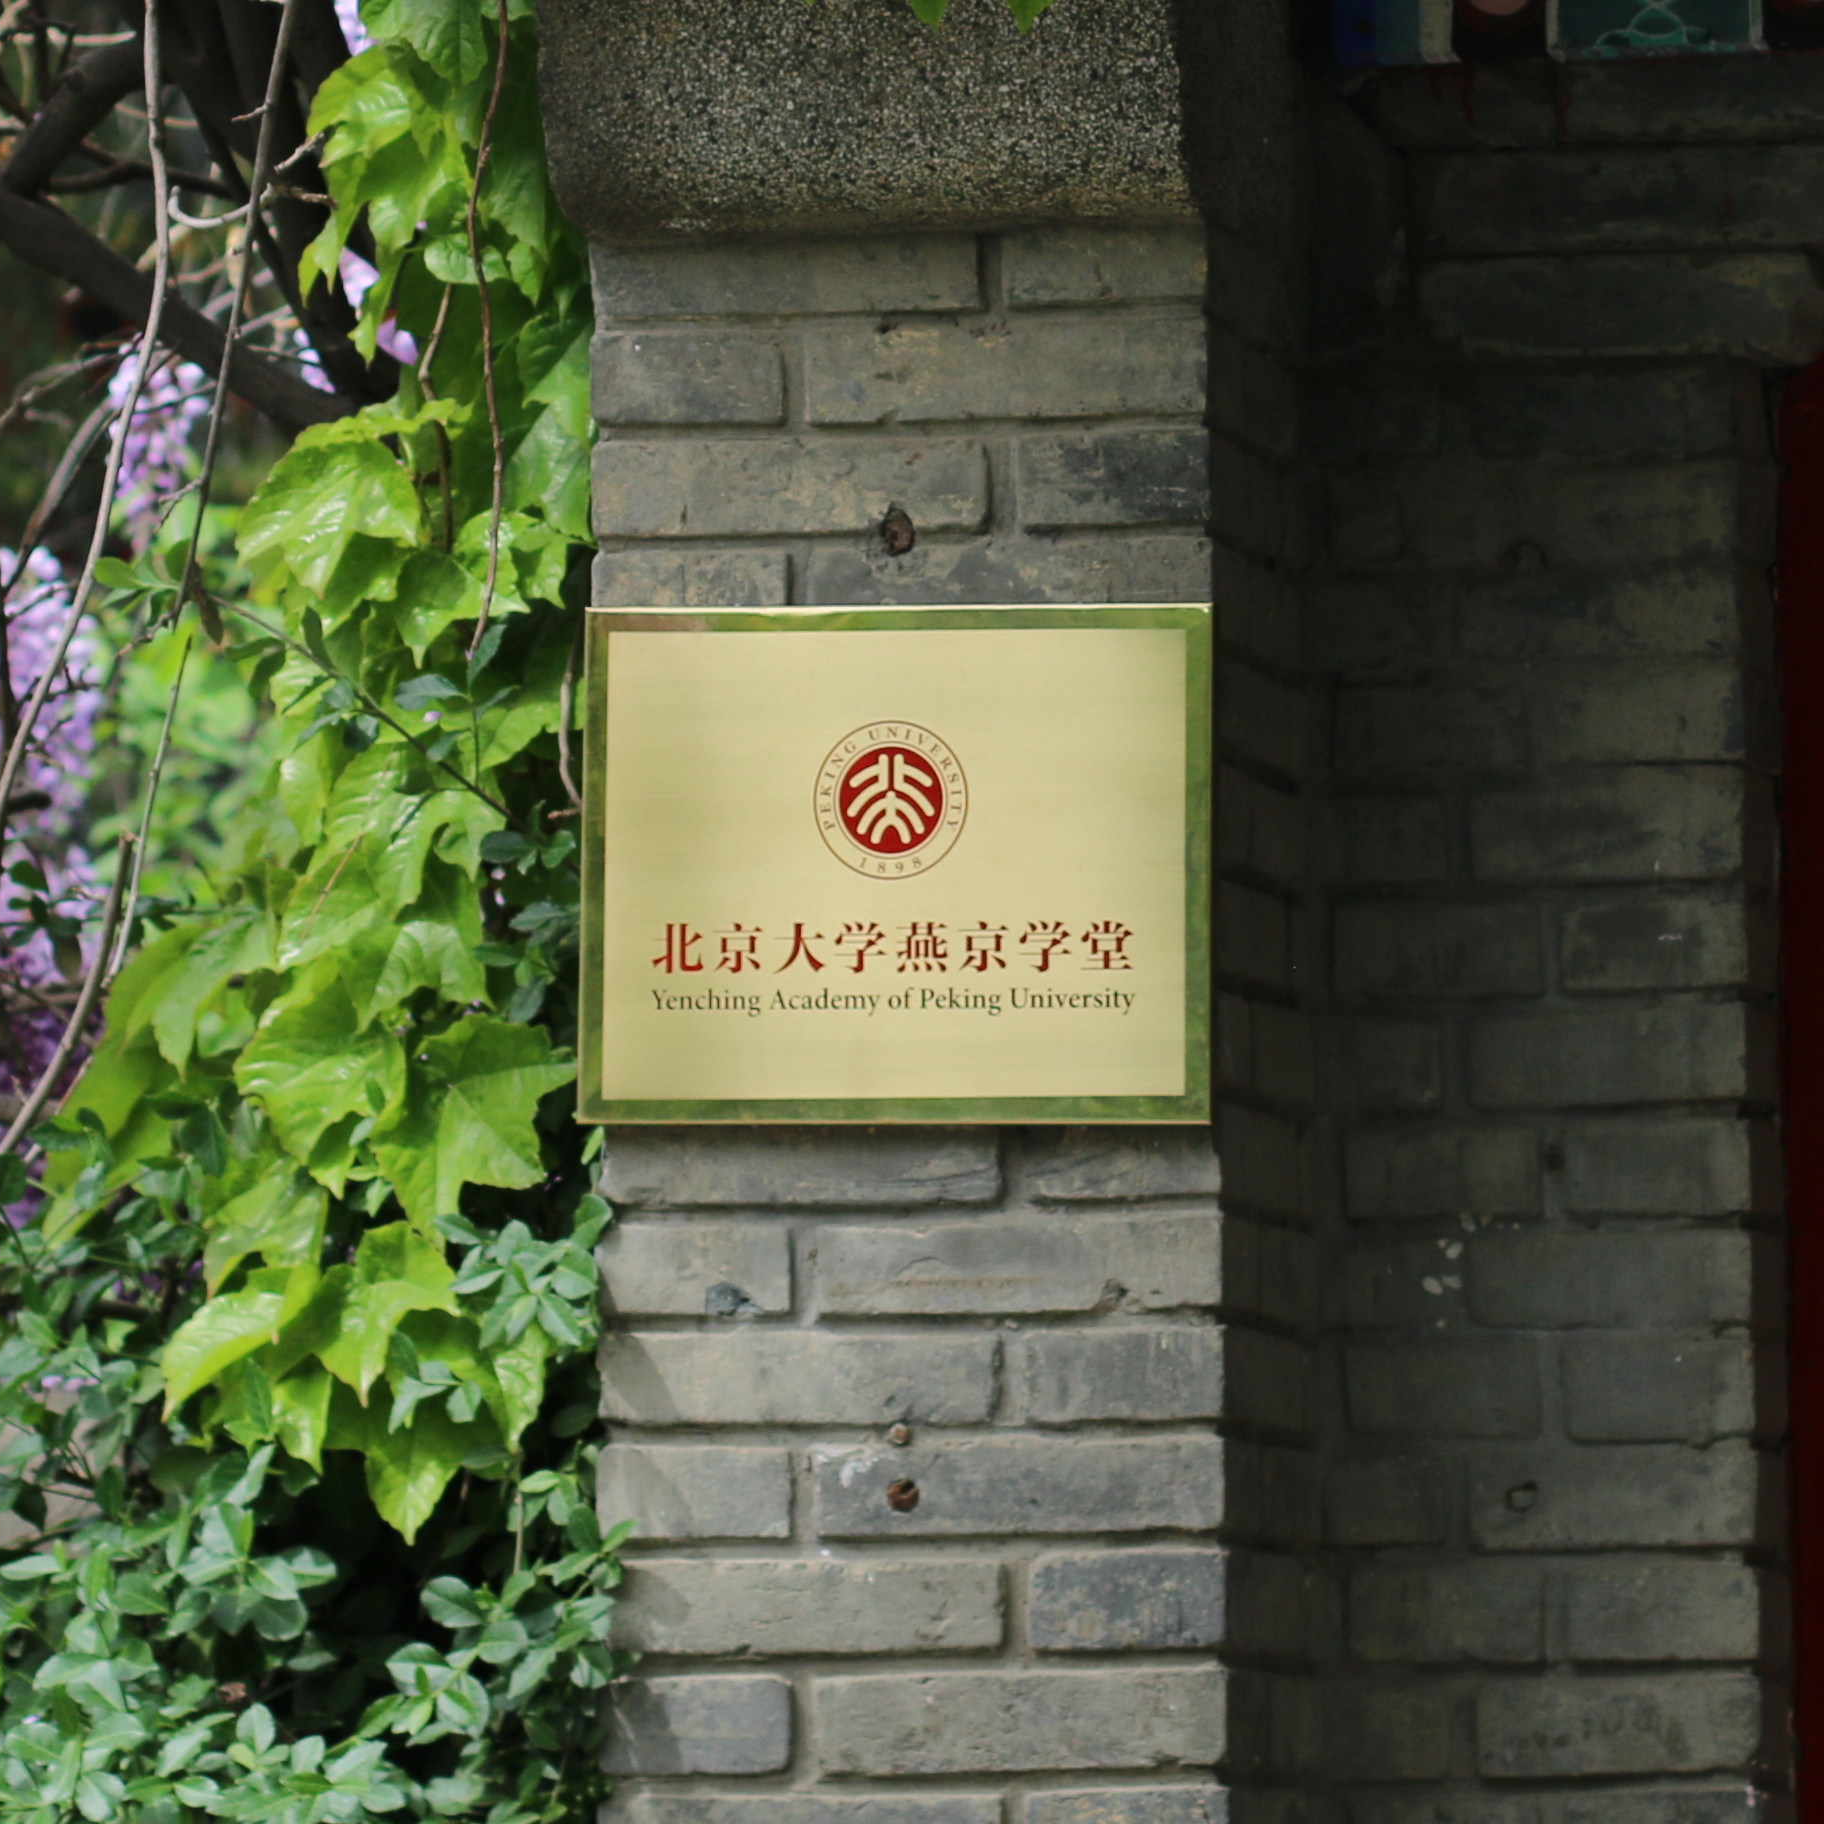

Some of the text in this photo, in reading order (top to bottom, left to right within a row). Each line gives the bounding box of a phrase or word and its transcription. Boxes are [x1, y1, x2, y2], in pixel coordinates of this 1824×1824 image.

[819, 726, 963, 832] PEKING UNIVERSITY
[860, 856, 922, 873] 1898
[652, 920, 1135, 974] 北京大学燕京学堂
[652, 987, 1136, 1017] Yenching Academy of Peking University
